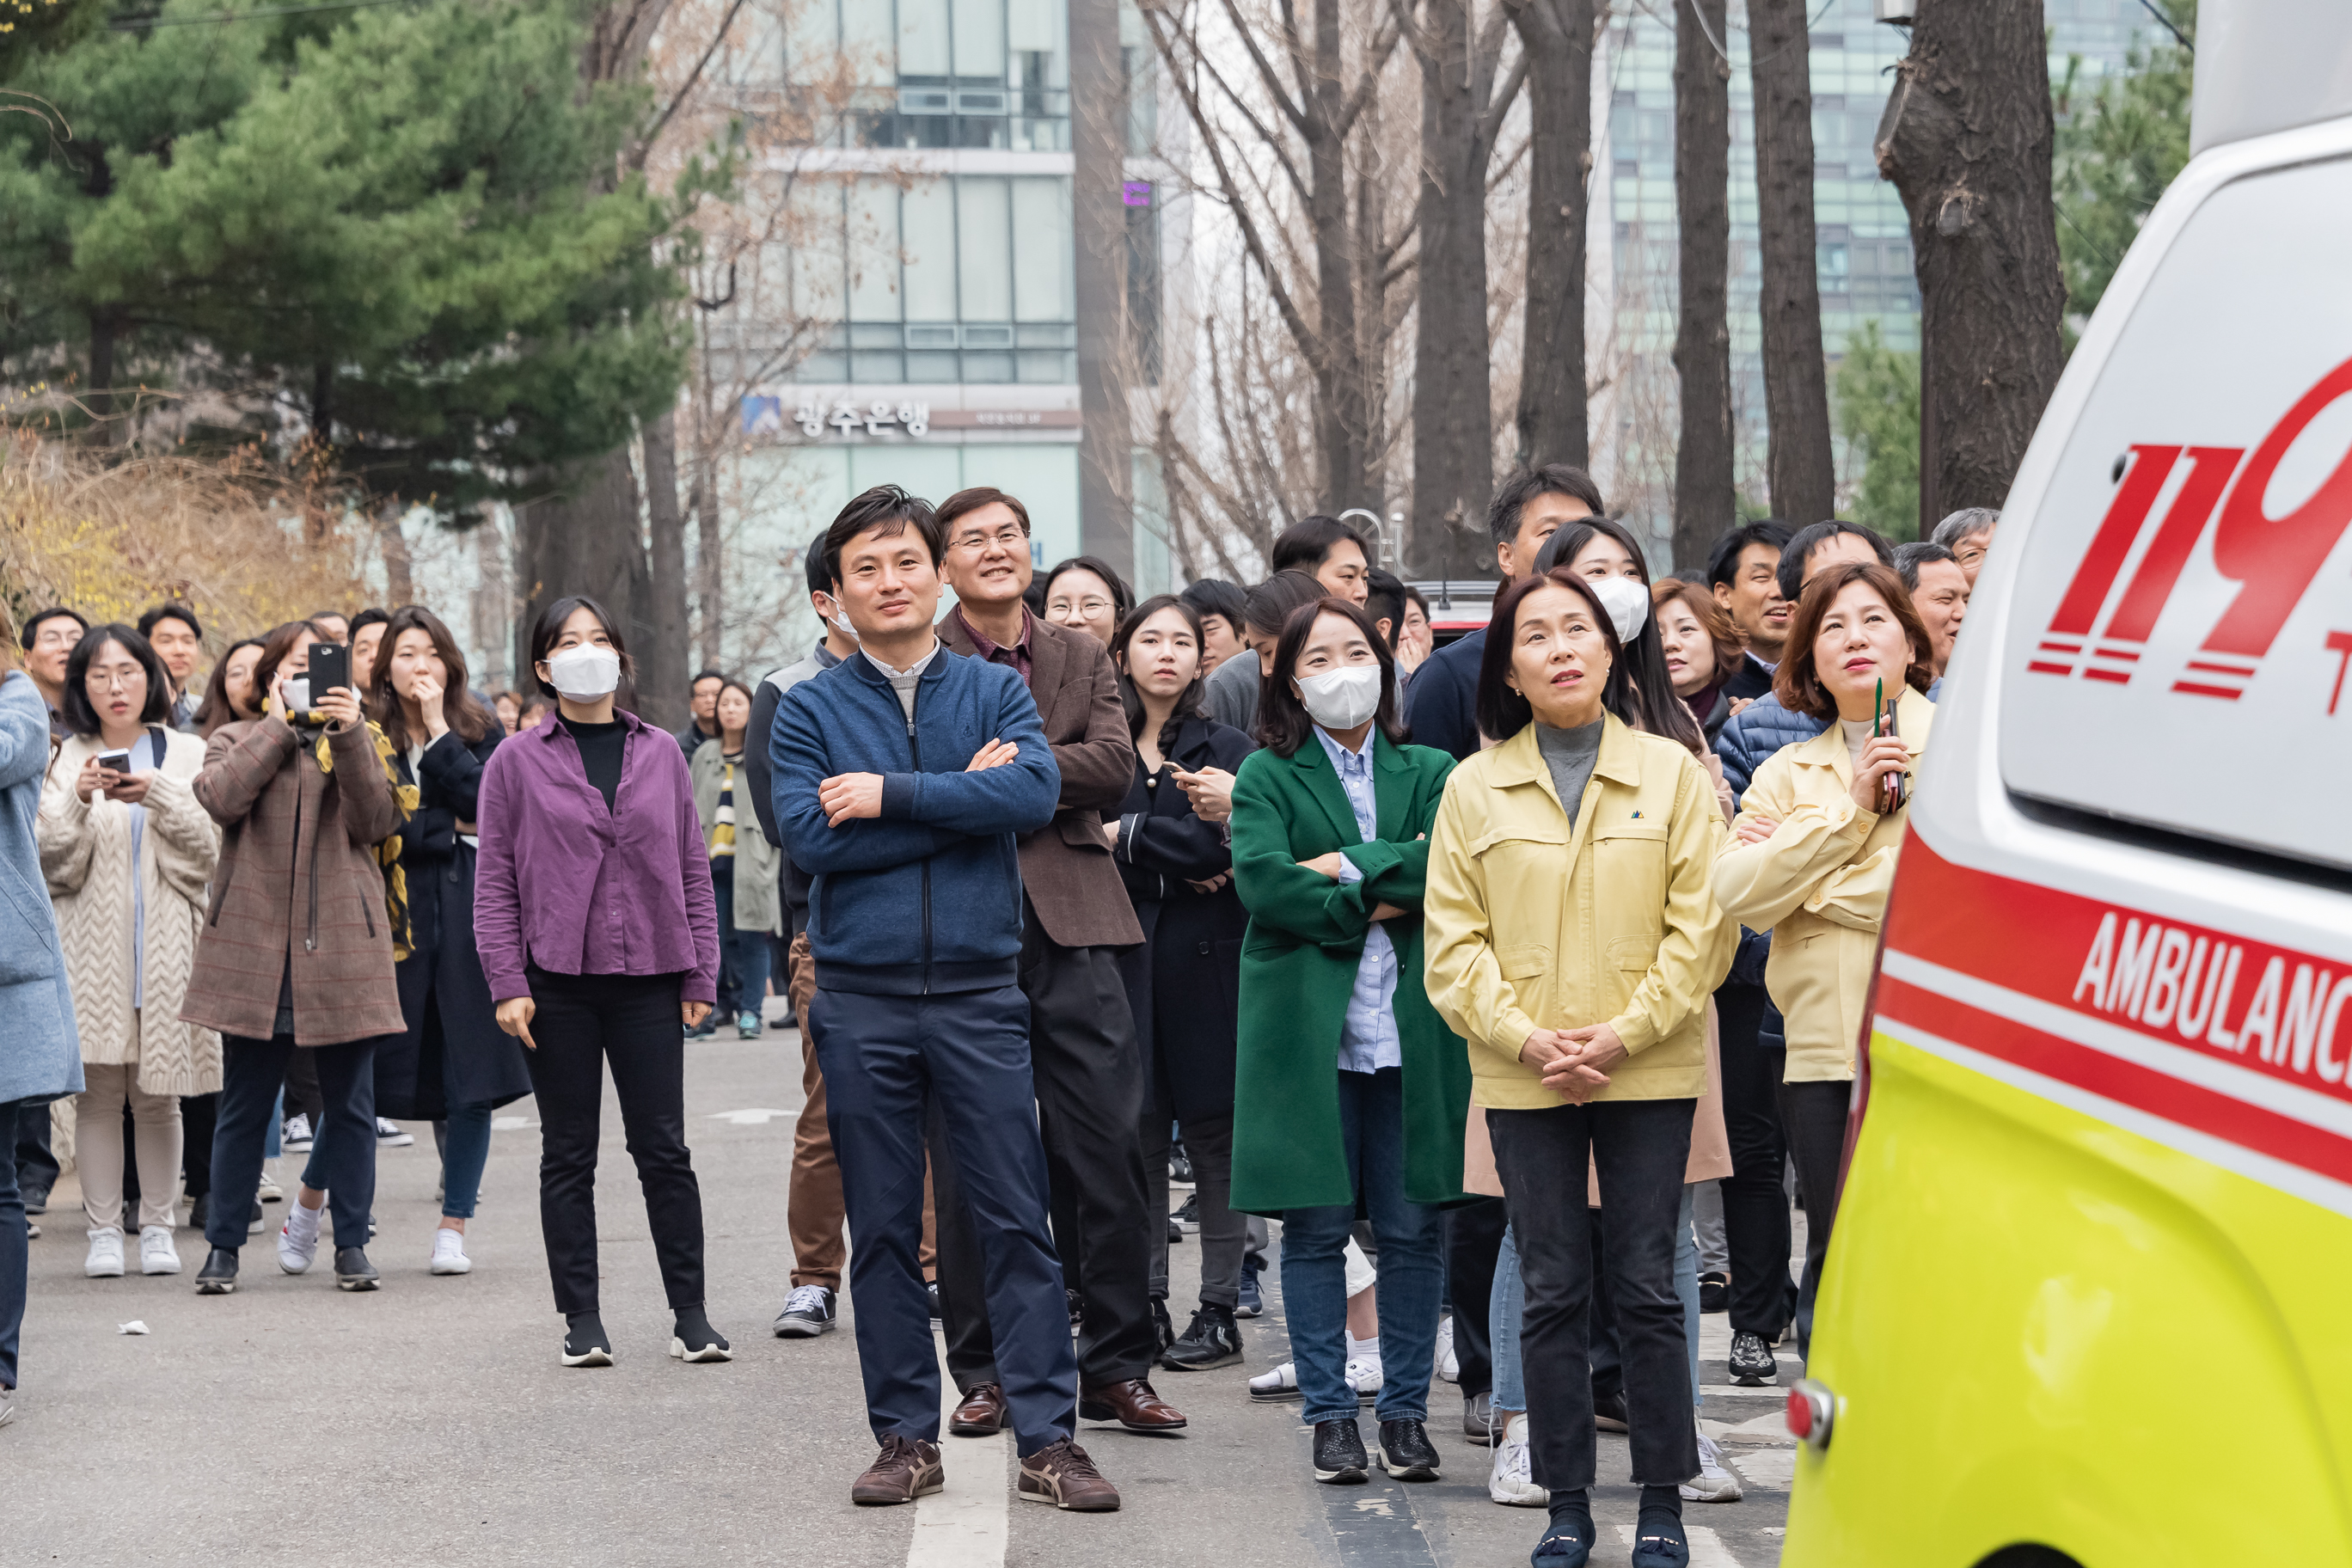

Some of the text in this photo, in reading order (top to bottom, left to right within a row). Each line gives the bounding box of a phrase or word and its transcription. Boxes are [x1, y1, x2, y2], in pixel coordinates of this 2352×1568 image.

[793, 400, 930, 438] 광주은행
[2027, 354, 2352, 701] 119
[2072, 911, 2352, 1089] AMBULANC
